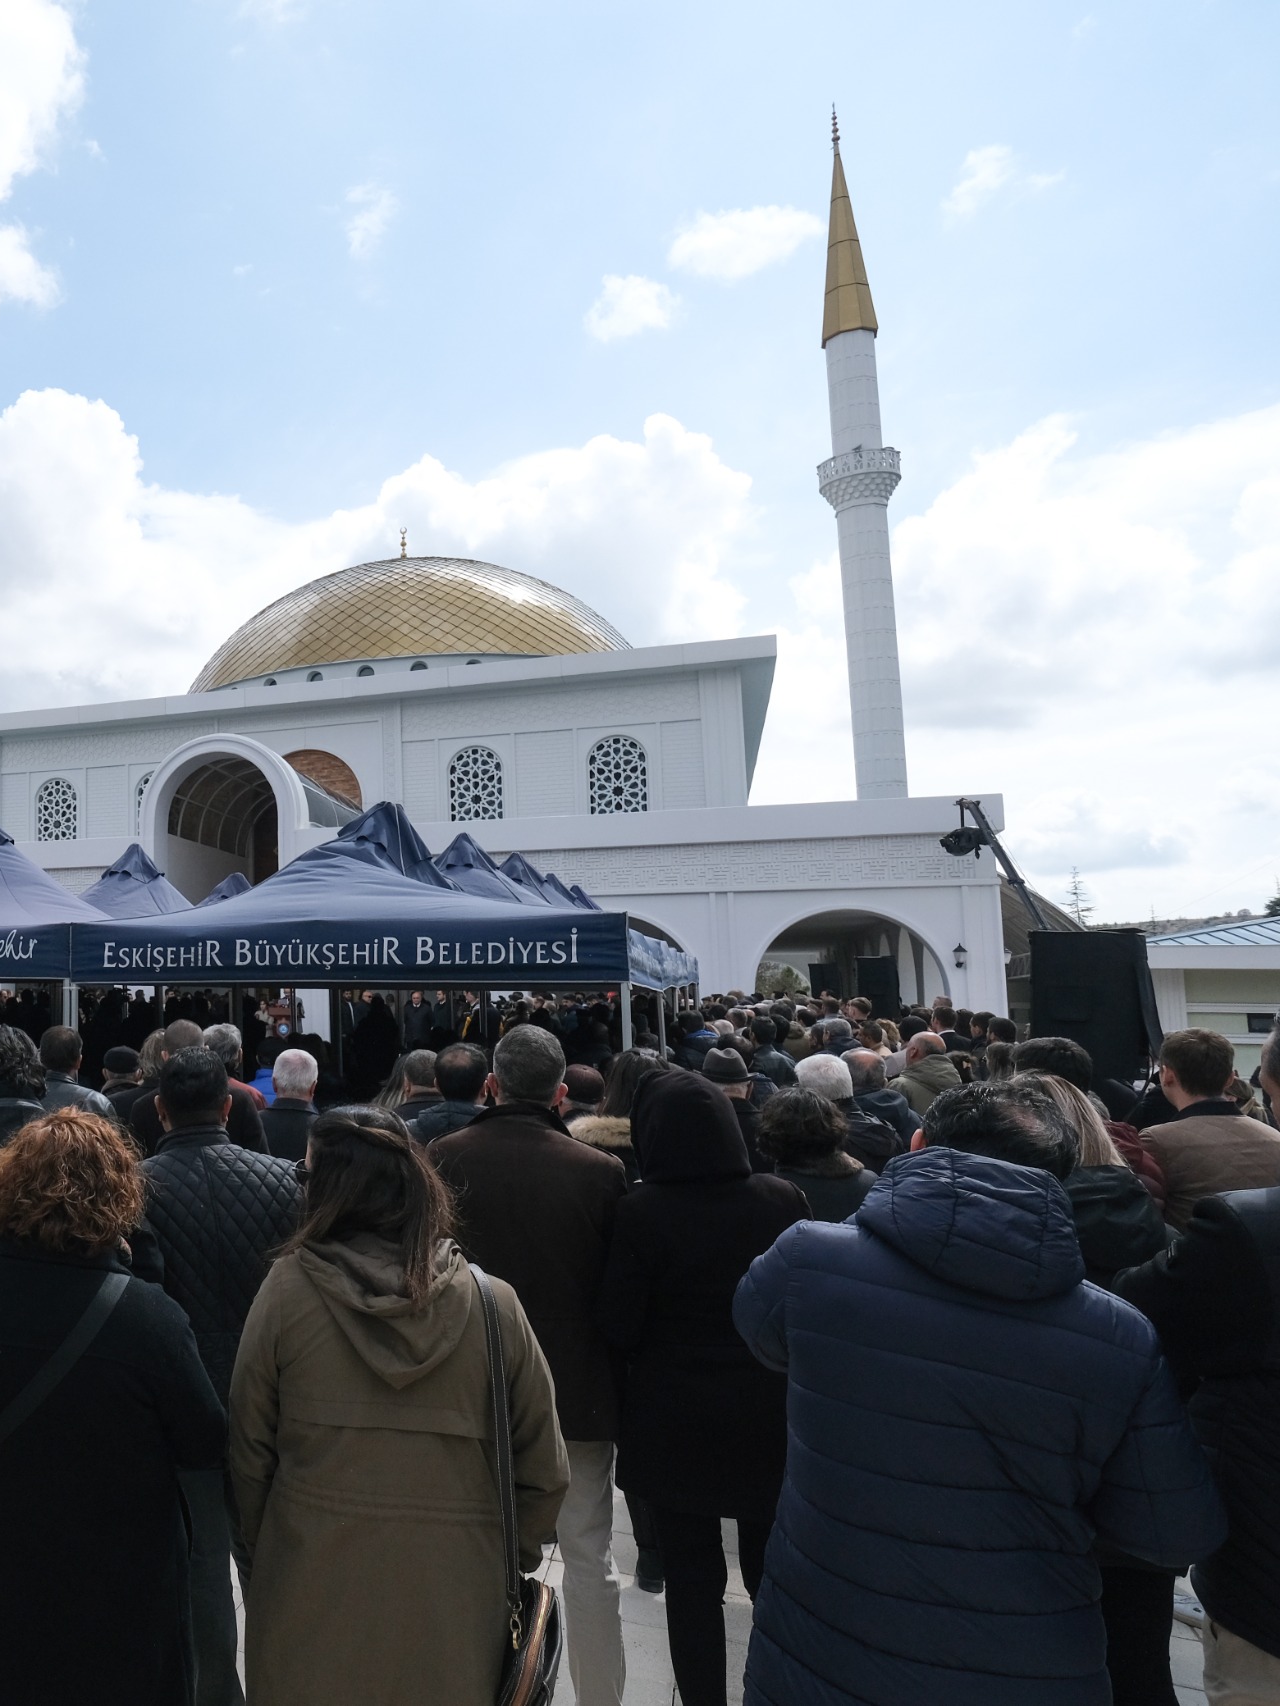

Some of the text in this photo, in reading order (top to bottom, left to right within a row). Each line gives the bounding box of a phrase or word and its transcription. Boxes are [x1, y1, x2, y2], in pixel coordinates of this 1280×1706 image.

[103, 927, 578, 972] ESKİŞEHİR BÜYÜKŞEHİR BELEDİYESİ
